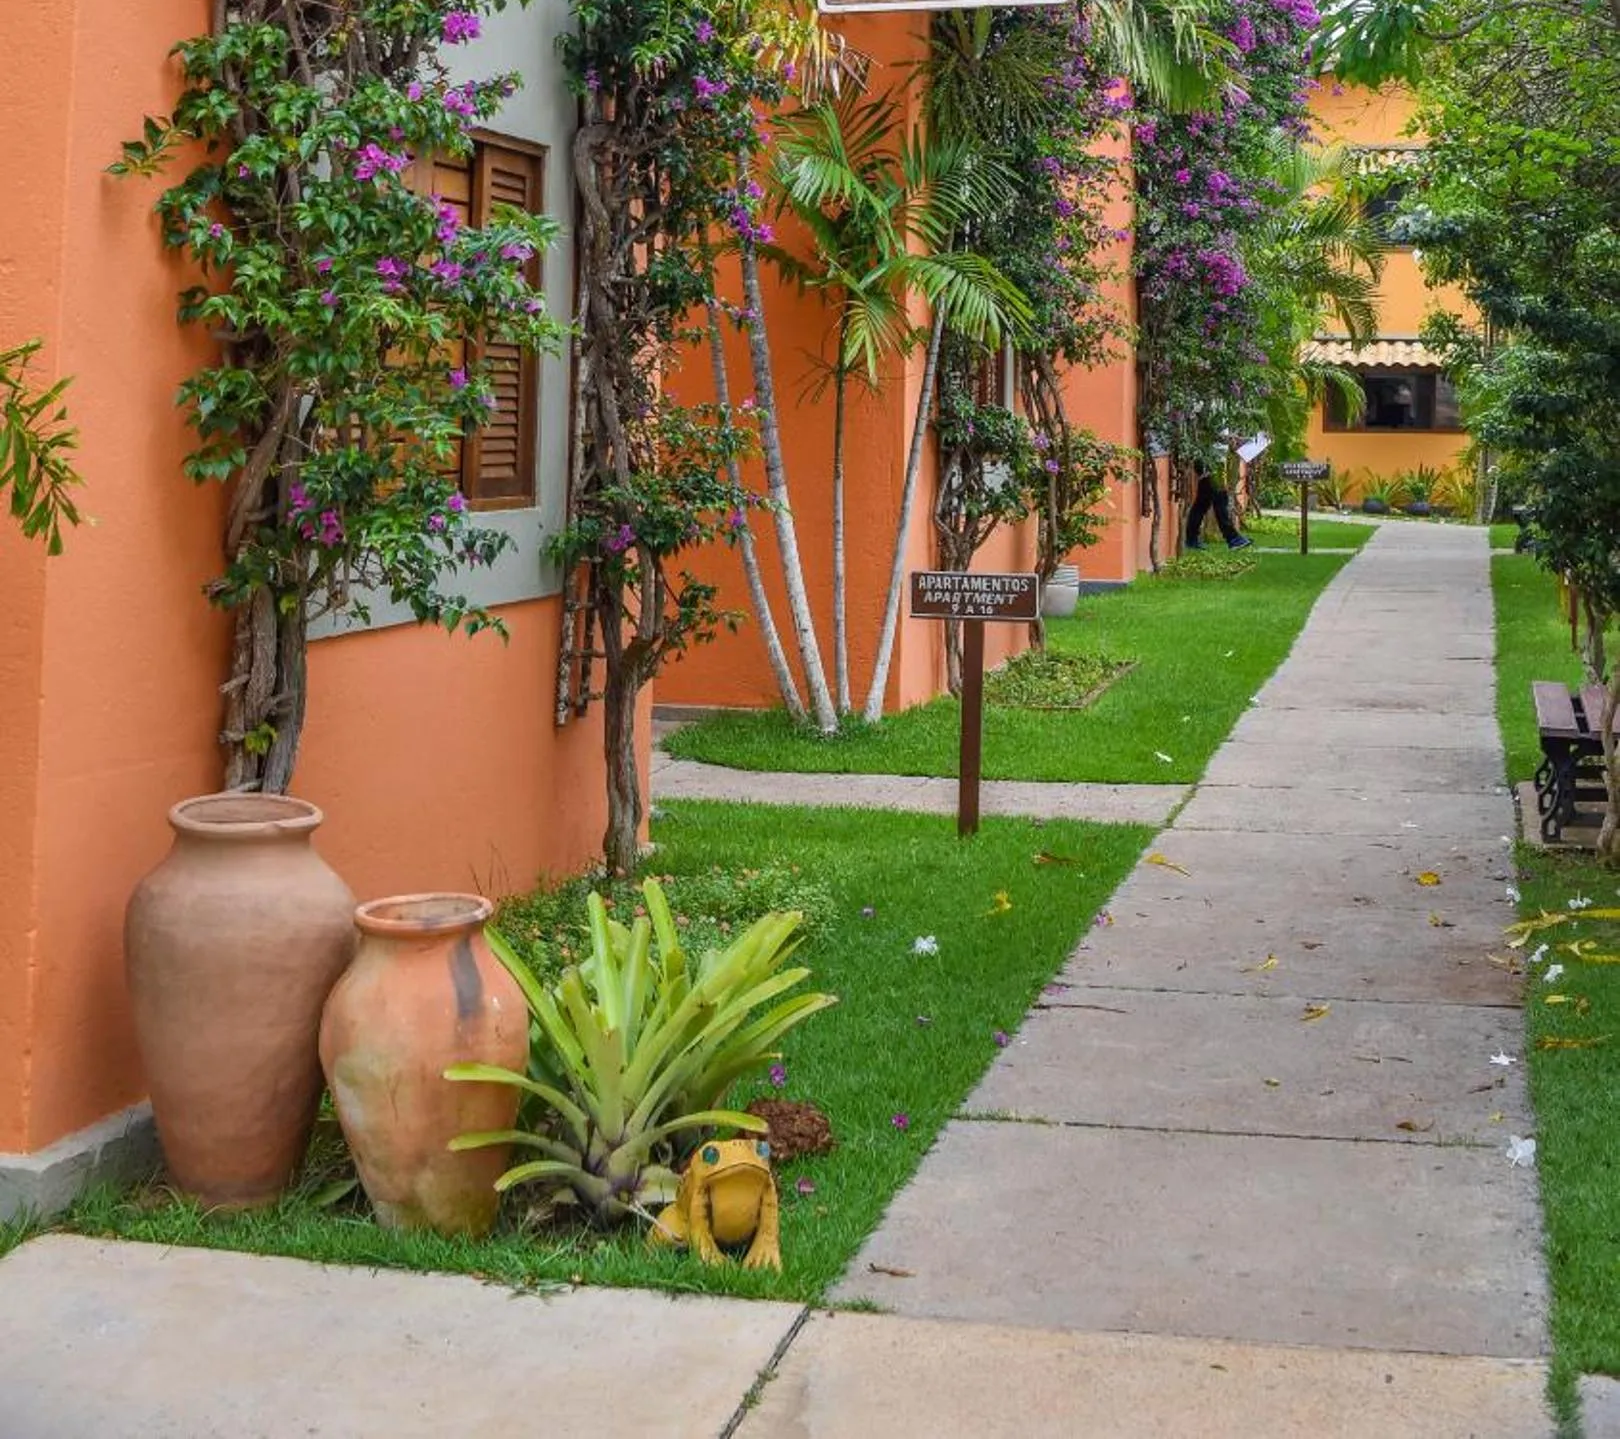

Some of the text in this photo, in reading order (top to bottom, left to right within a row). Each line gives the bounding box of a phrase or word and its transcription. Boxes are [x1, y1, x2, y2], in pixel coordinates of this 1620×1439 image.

[919, 575, 1030, 592] APARTAMENTOS
[923, 592, 1018, 605] APARTMENT
[965, 604, 975, 614] A
[980, 605, 993, 615] 16
